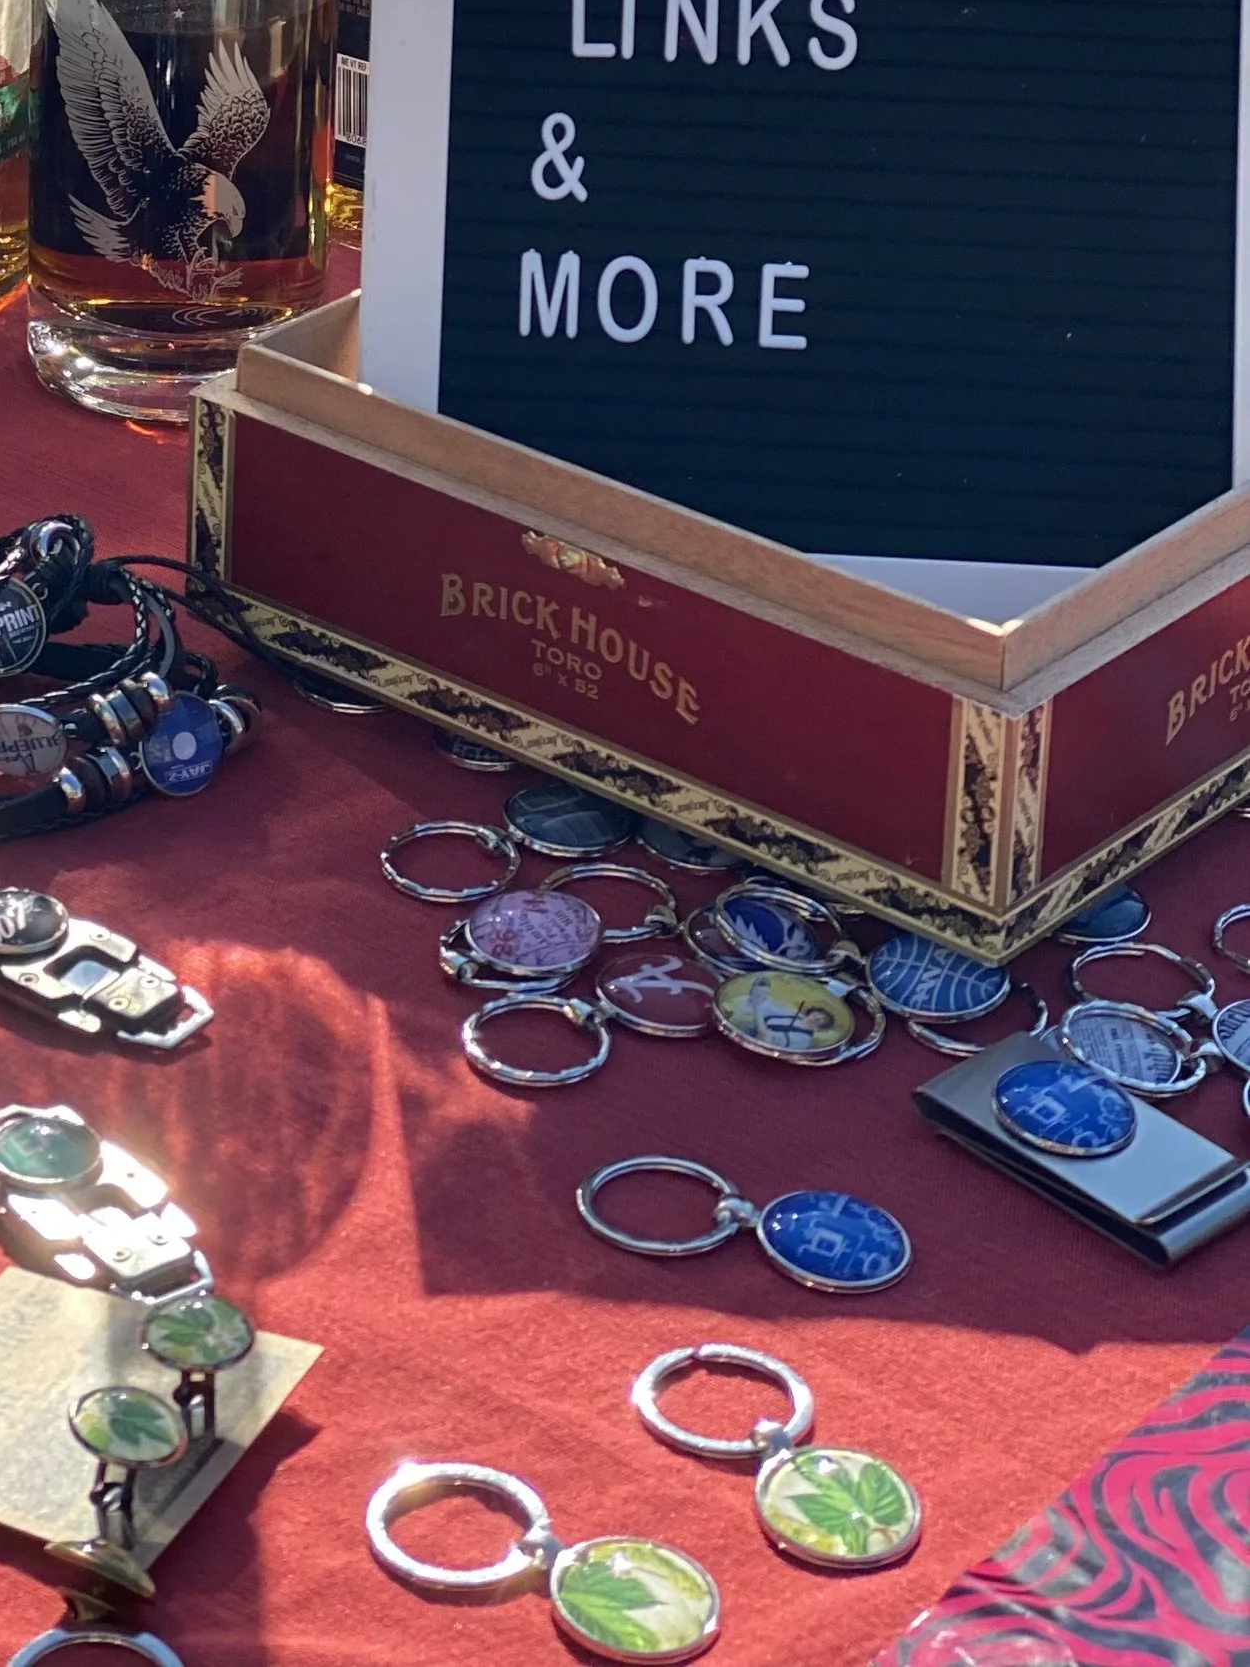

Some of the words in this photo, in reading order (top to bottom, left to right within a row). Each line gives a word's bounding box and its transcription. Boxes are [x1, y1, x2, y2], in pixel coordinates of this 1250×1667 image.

[531, 112, 588, 203] &
[519, 247, 810, 351] MORE
[439, 572, 560, 640] BRICK
[569, 604, 701, 727] HOUSE
[530, 637, 603, 681] TORO
[573, 677, 600, 700] 52
